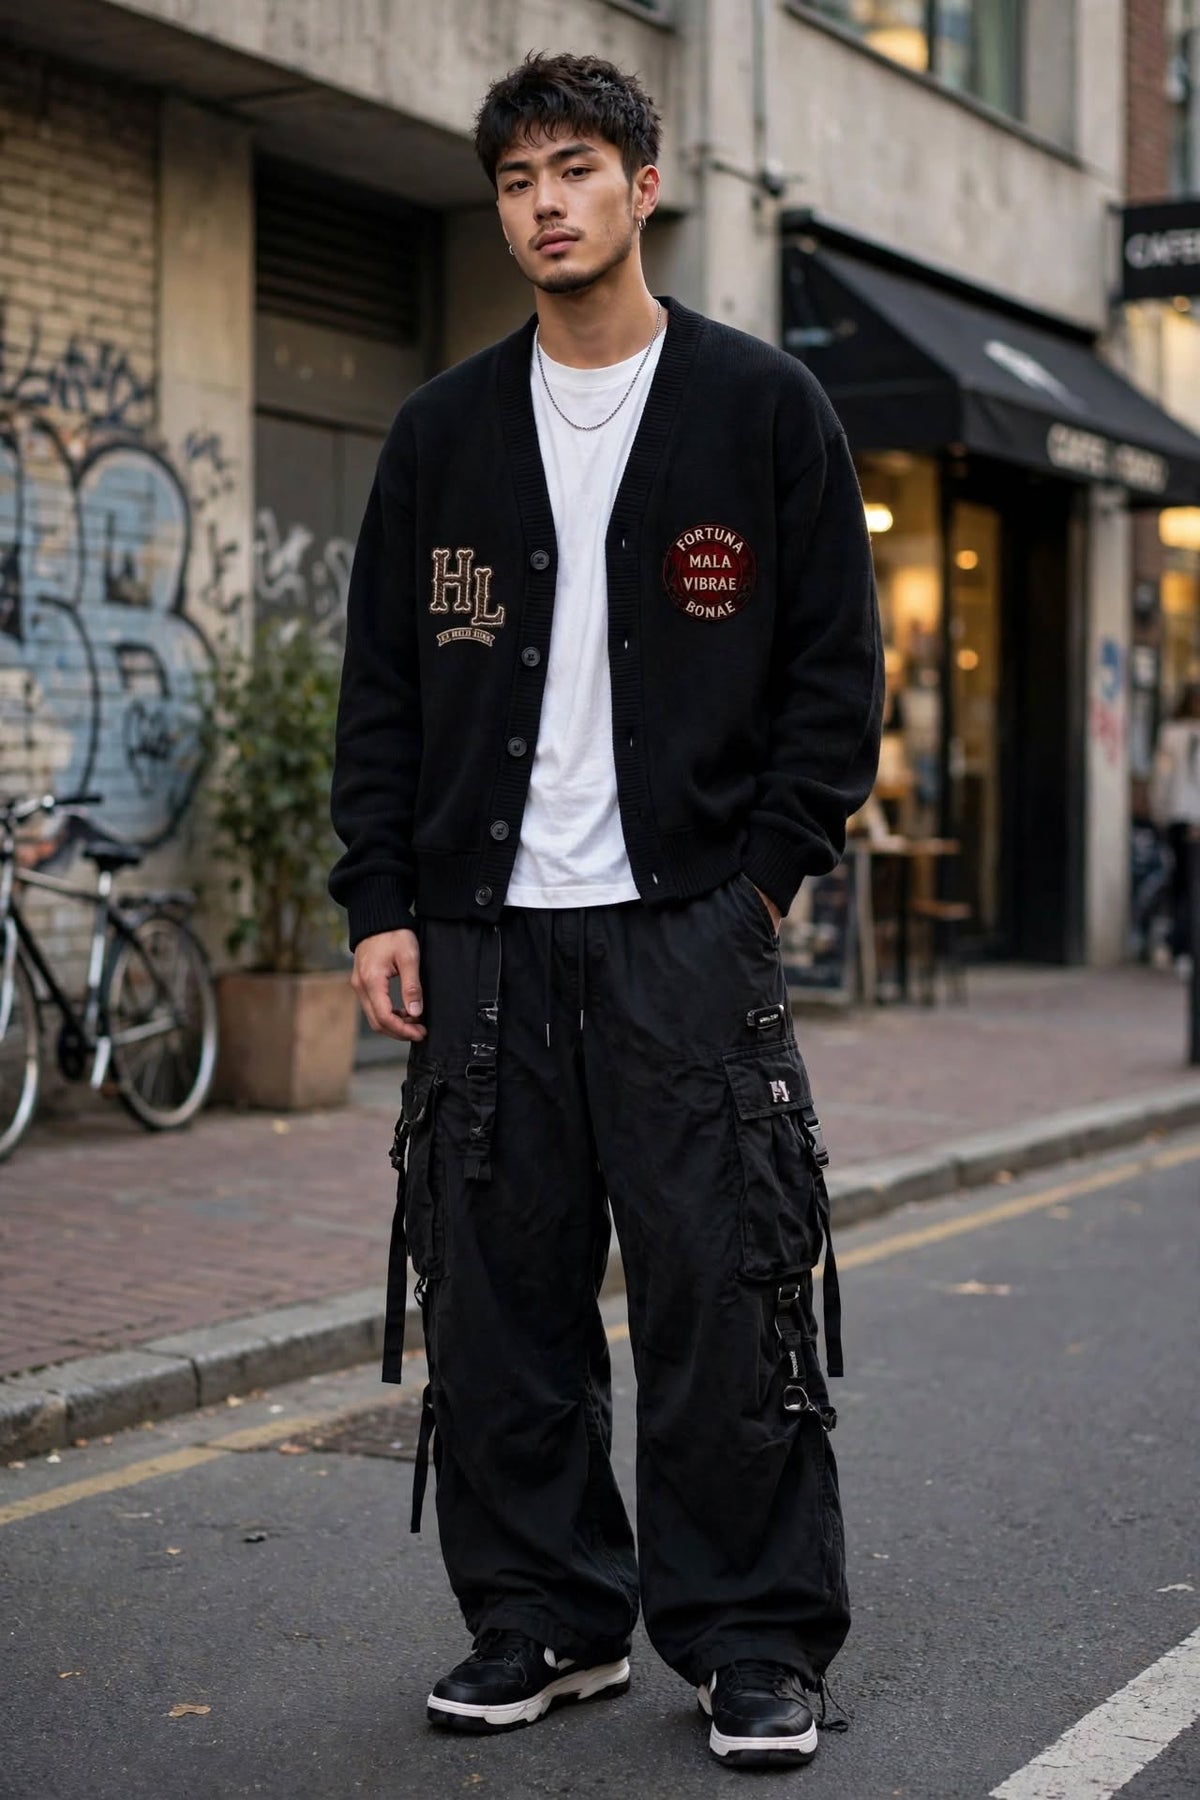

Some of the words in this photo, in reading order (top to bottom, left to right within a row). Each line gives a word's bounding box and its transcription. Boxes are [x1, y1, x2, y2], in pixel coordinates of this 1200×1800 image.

[676, 527, 744, 554] FORTUNA
[689, 554, 733, 569] MALA
[683, 576, 737, 592] VIBRAE
[685, 600, 736, 618] BONAE
